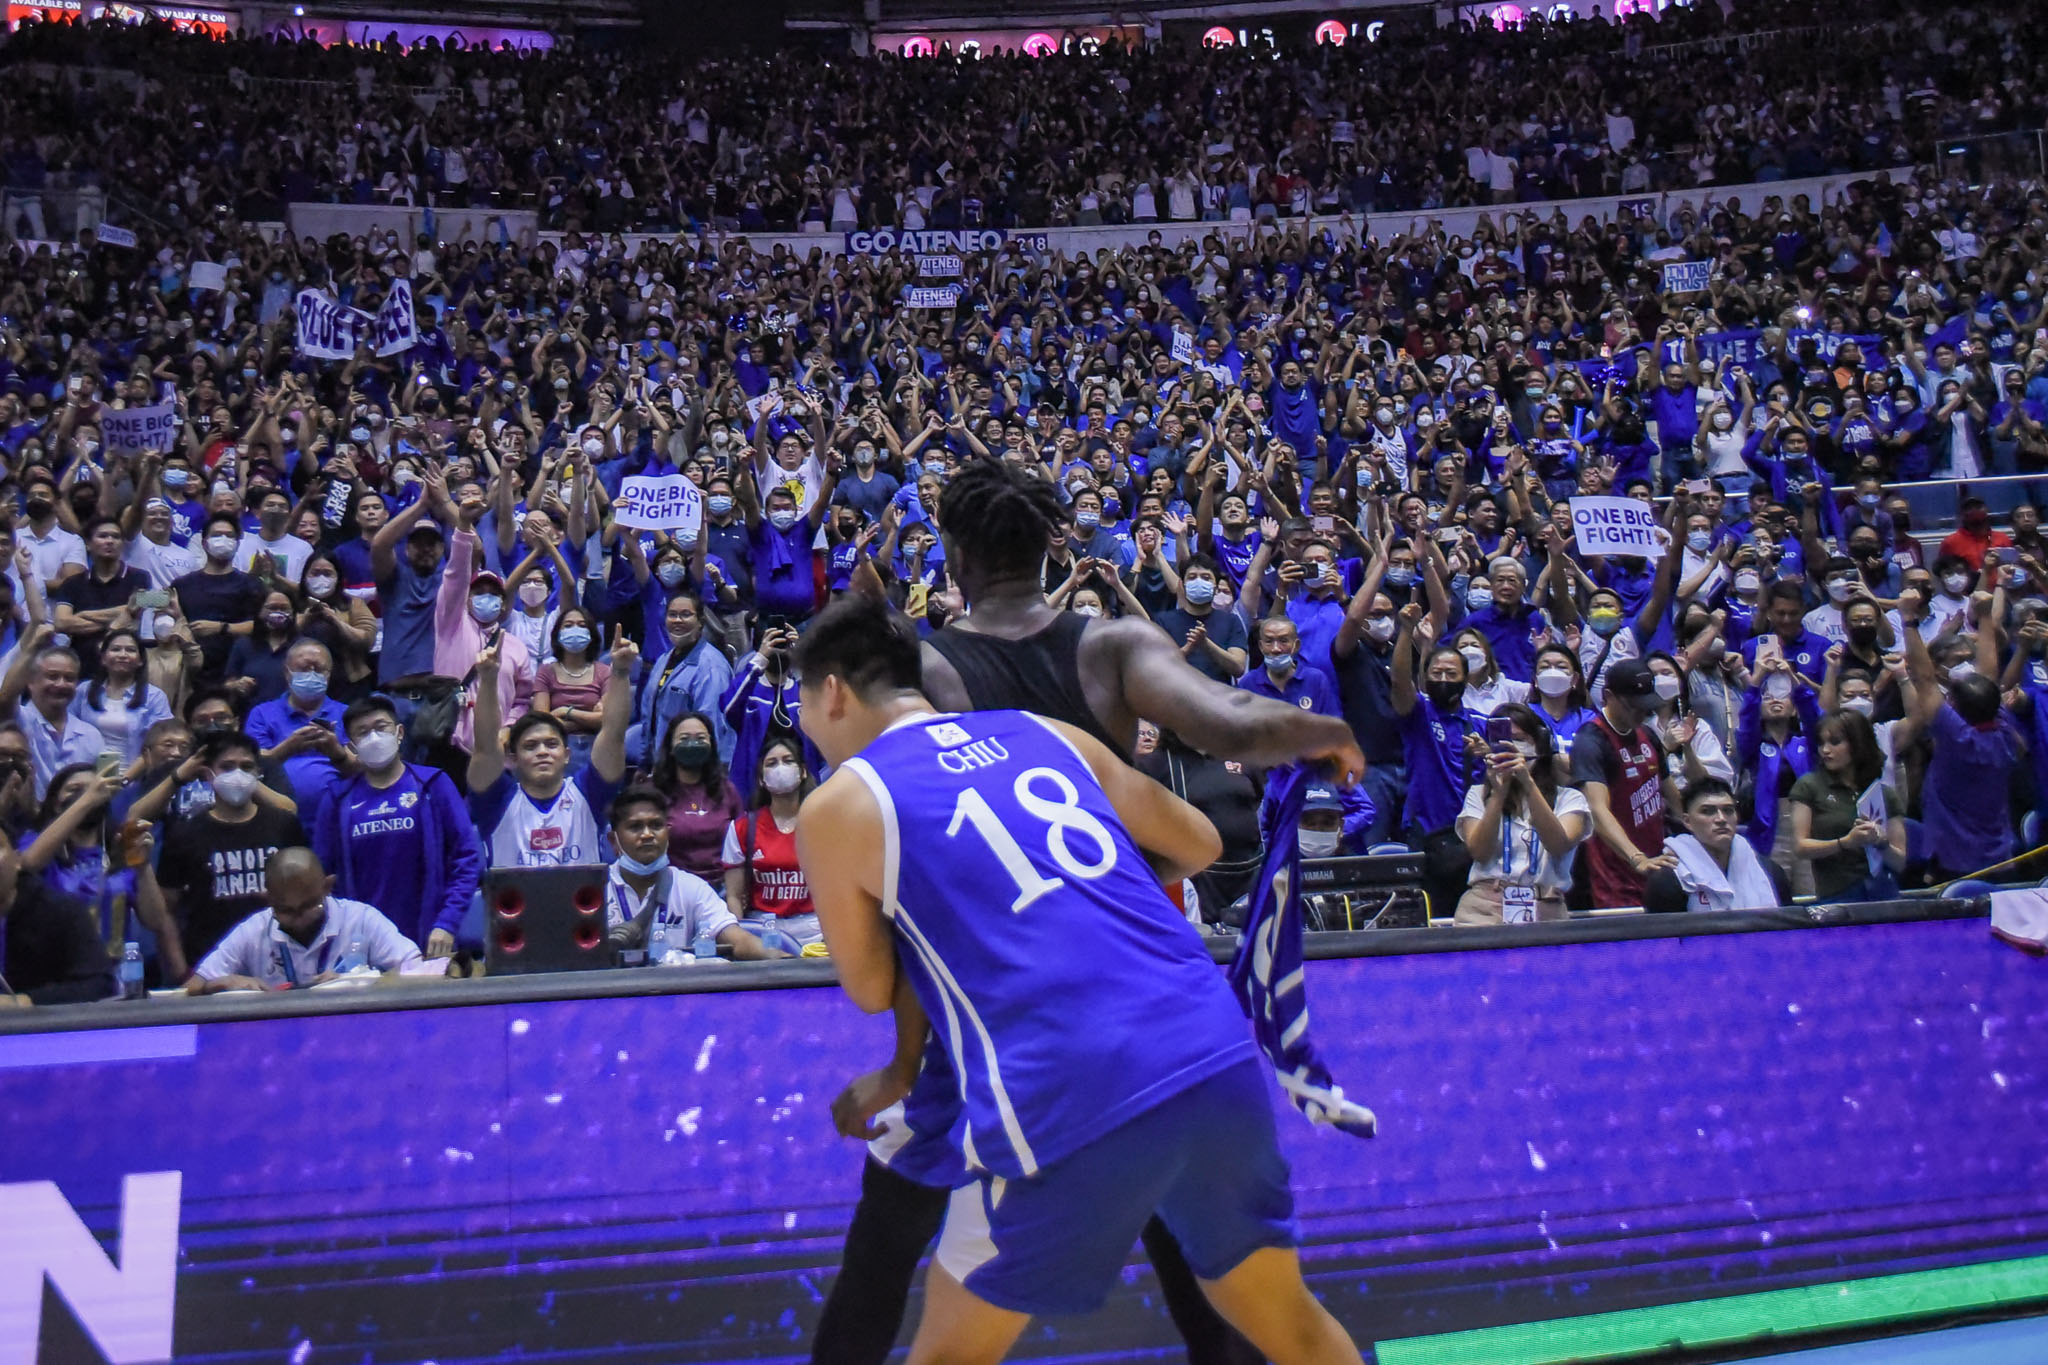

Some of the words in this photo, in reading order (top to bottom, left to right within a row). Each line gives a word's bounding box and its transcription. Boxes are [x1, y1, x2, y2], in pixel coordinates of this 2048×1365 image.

[159, 9, 209, 21] AVAILAE
[210, 14, 226, 22] ON
[850, 231, 896, 254] GO
[900, 230, 1002, 253] ATENEO
[1016, 237, 1046, 251] 218
[921, 257, 960, 269] ATENEO
[910, 287, 953, 301] ATENEO
[1704, 339, 1747, 363] THE
[102, 417, 142, 432] ONE
[145, 413, 173, 431] BIG
[624, 486, 667, 503] ONE
[668, 485, 699, 504] BIG
[628, 501, 692, 519] FIGHT!
[1574, 507, 1622, 526] ONE
[1623, 508, 1655, 527] BIG
[1585, 526, 1653, 546] FIGHT!
[937, 736, 1009, 774] CHIU
[352, 816, 415, 838] ATENEO
[945, 767, 1117, 914] 18
[1302, 870, 1335, 881] YAMAHA
[0, 1170, 182, 1365] N
